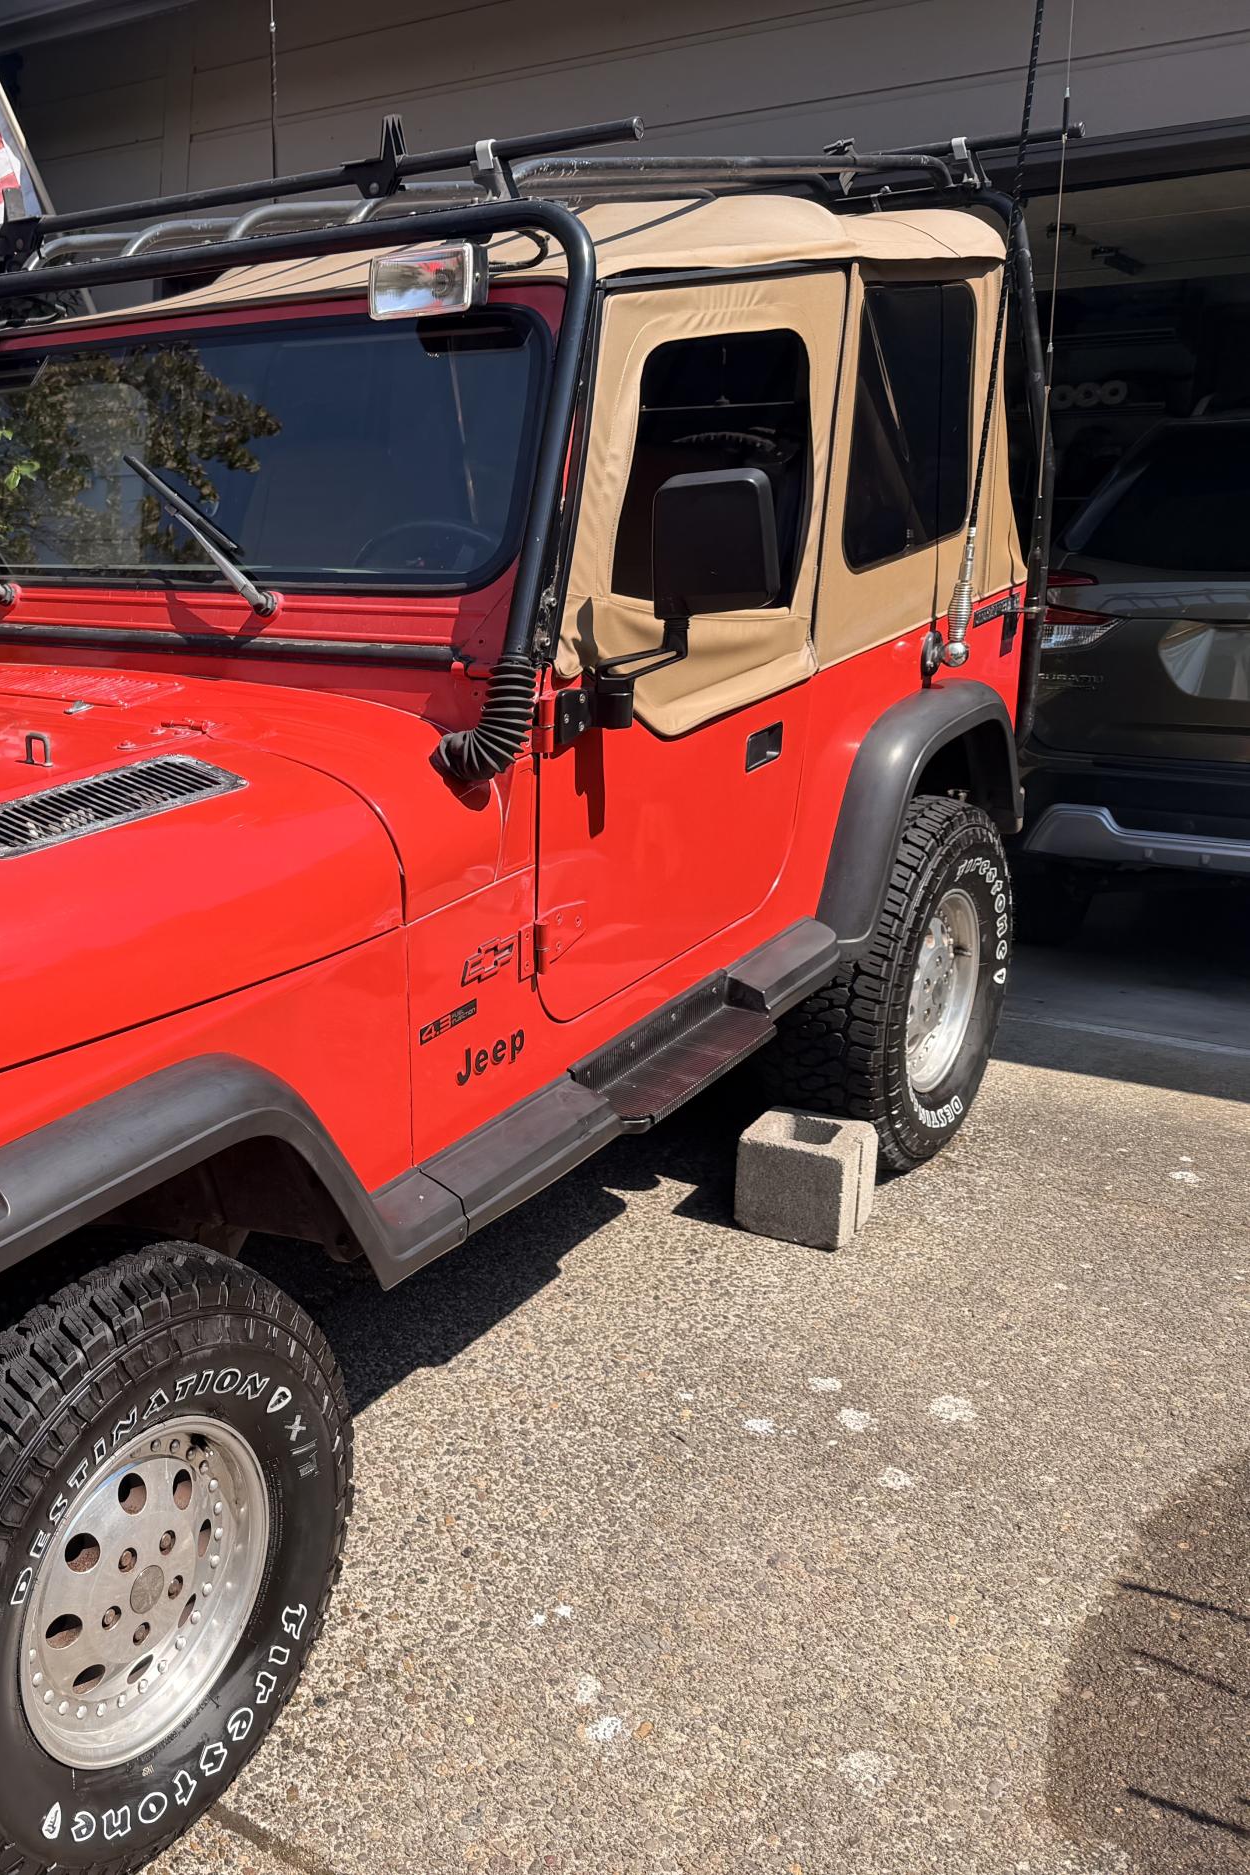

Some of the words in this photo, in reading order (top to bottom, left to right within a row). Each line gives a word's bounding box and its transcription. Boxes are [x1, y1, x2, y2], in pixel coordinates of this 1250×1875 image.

[954, 857, 1008, 960] Firestone
[422, 1014, 451, 1041] 4.3
[455, 1028, 525, 1086] Jeep
[10, 1367, 270, 1606] DESTINATION
[72, 1602, 309, 1843] Firestone
